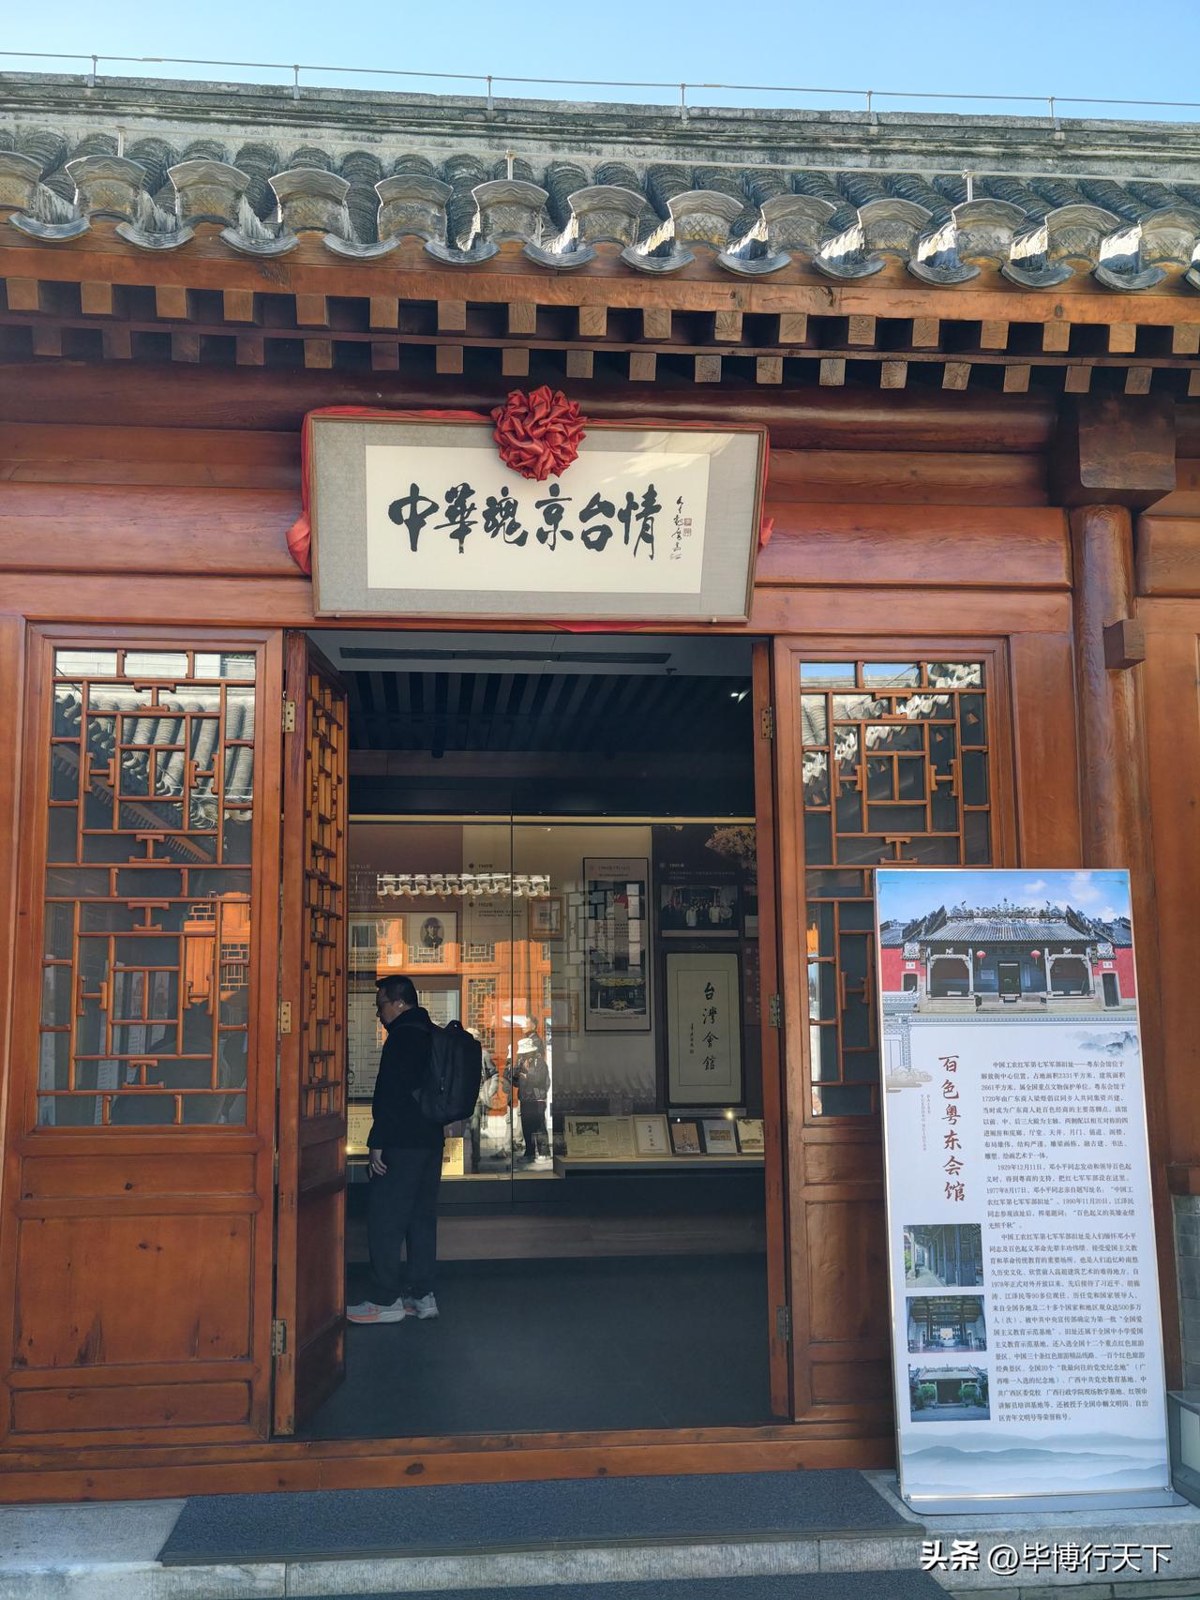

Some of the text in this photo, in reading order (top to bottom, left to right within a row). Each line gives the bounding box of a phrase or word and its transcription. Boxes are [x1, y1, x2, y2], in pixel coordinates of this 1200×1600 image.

[388, 482, 662, 560] 中華魂京台情
[938, 1054, 966, 1203] 百色粤东会馆
